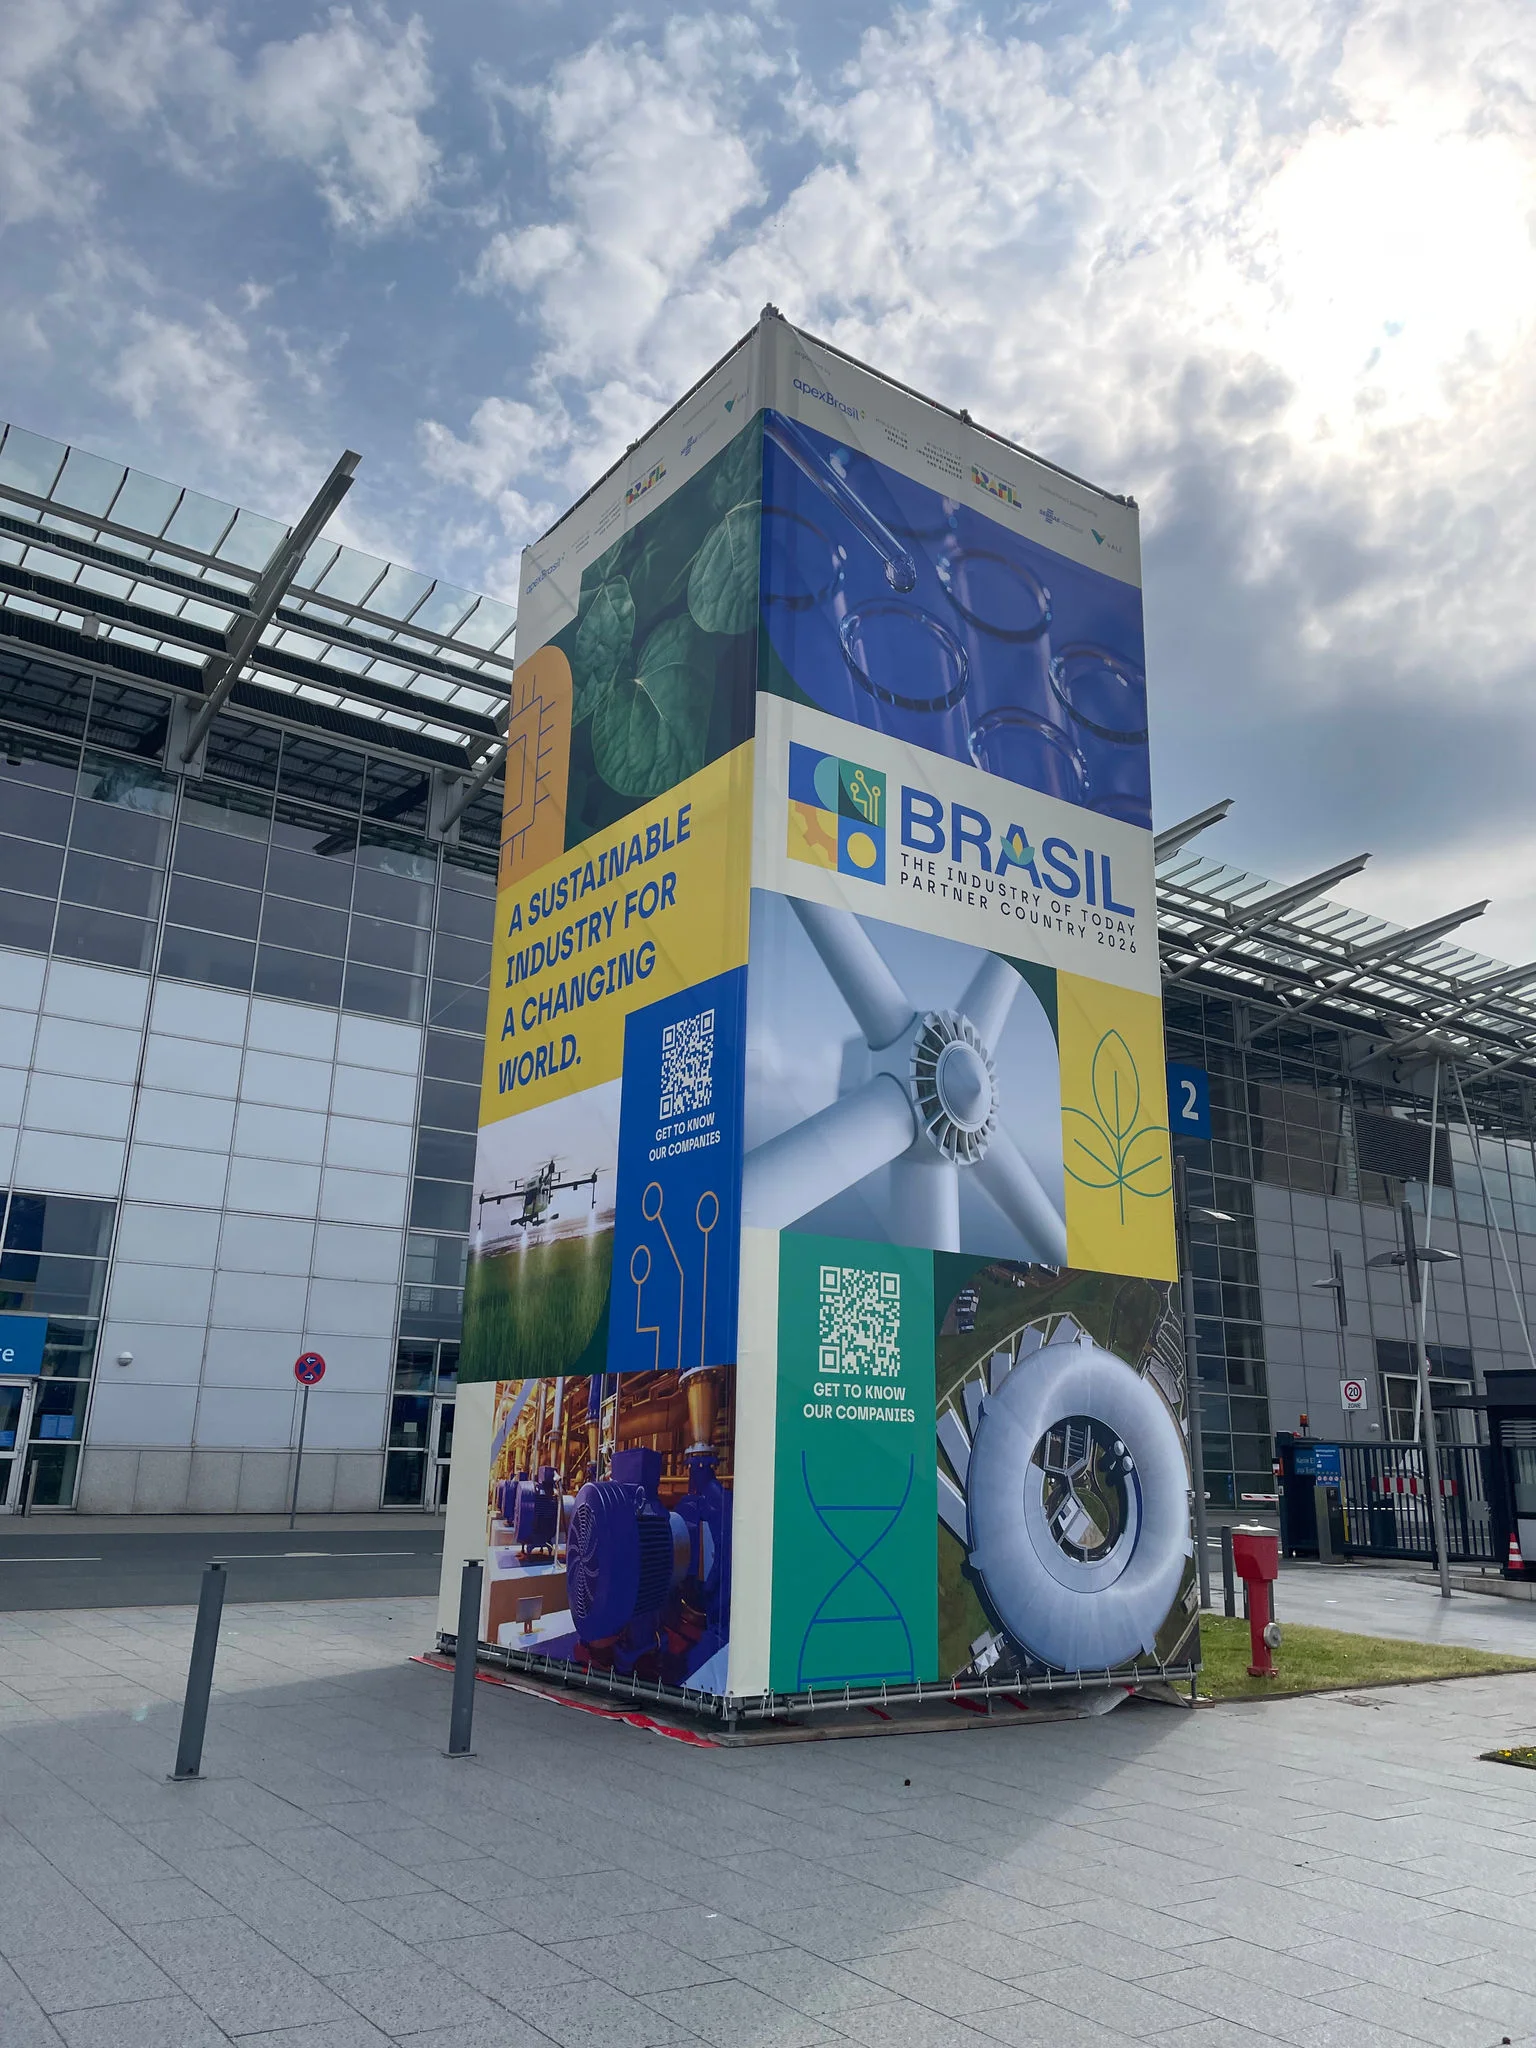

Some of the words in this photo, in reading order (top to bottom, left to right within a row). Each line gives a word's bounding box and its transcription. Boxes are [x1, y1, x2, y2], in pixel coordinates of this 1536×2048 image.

[793, 378, 859, 421] apexBrasil
[508, 903, 523, 938] A
[528, 803, 692, 926] SUSTAINABLE
[901, 785, 1135, 918] BRASIL
[901, 853, 935, 876] THE
[947, 867, 1040, 907] INDUSTRY
[1051, 900, 1071, 916] OF
[1081, 909, 1135, 936] TODAY
[901, 872, 987, 909] PARTNER
[1001, 902, 1085, 938] COUNTRY
[1097, 932, 1136, 954] 2026
[505, 900, 618, 988] INDUSTRY
[624, 871, 677, 929] FOR
[501, 1007, 516, 1042] A
[521, 940, 656, 1031] CHANGING
[499, 1034, 582, 1094] WORLD.
[1181, 1080, 1199, 1121] 2
[649, 1146, 667, 1162] OUR
[668, 1130, 721, 1157] COMPANIES
[655, 1125, 672, 1142] GET
[674, 1121, 686, 1135] TO
[687, 1112, 715, 1132] KNOW
[803, 1403, 832, 1419] OUR
[835, 1405, 915, 1423] COMPANIES
[813, 1382, 840, 1397] GET
[843, 1383, 862, 1398] TO
[865, 1385, 906, 1401] KNOW
[1348, 1387, 1359, 1397] 20
